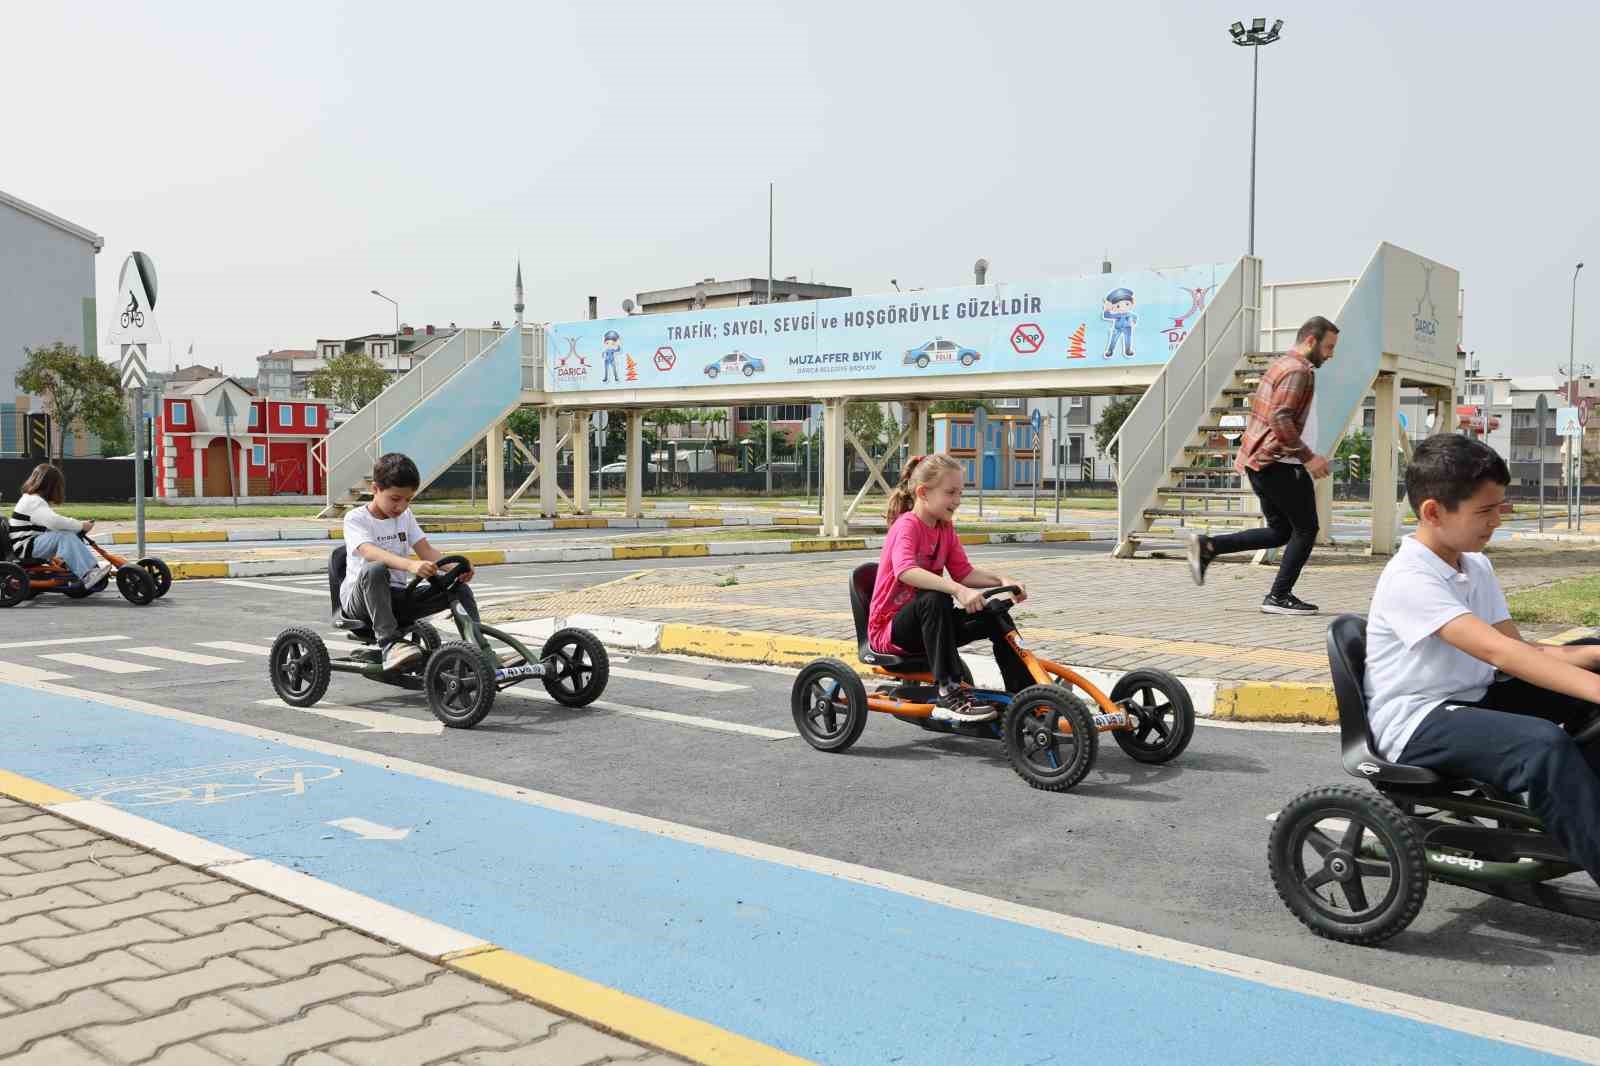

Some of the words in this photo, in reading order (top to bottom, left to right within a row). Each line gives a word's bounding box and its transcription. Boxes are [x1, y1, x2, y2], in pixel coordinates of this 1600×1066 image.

[667, 320, 717, 341] TRAFİK;
[723, 319, 768, 337] SAYGI,
[774, 312, 815, 333] SEVGİ
[821, 317, 838, 329] ve
[844, 302, 950, 328] HOŞGÖRÜYLE
[956, 293, 1042, 319] GÜZELDİR
[789, 352, 849, 366] MUZAFFER
[852, 350, 883, 362] BIYIK
[558, 367, 587, 376] DARICA
